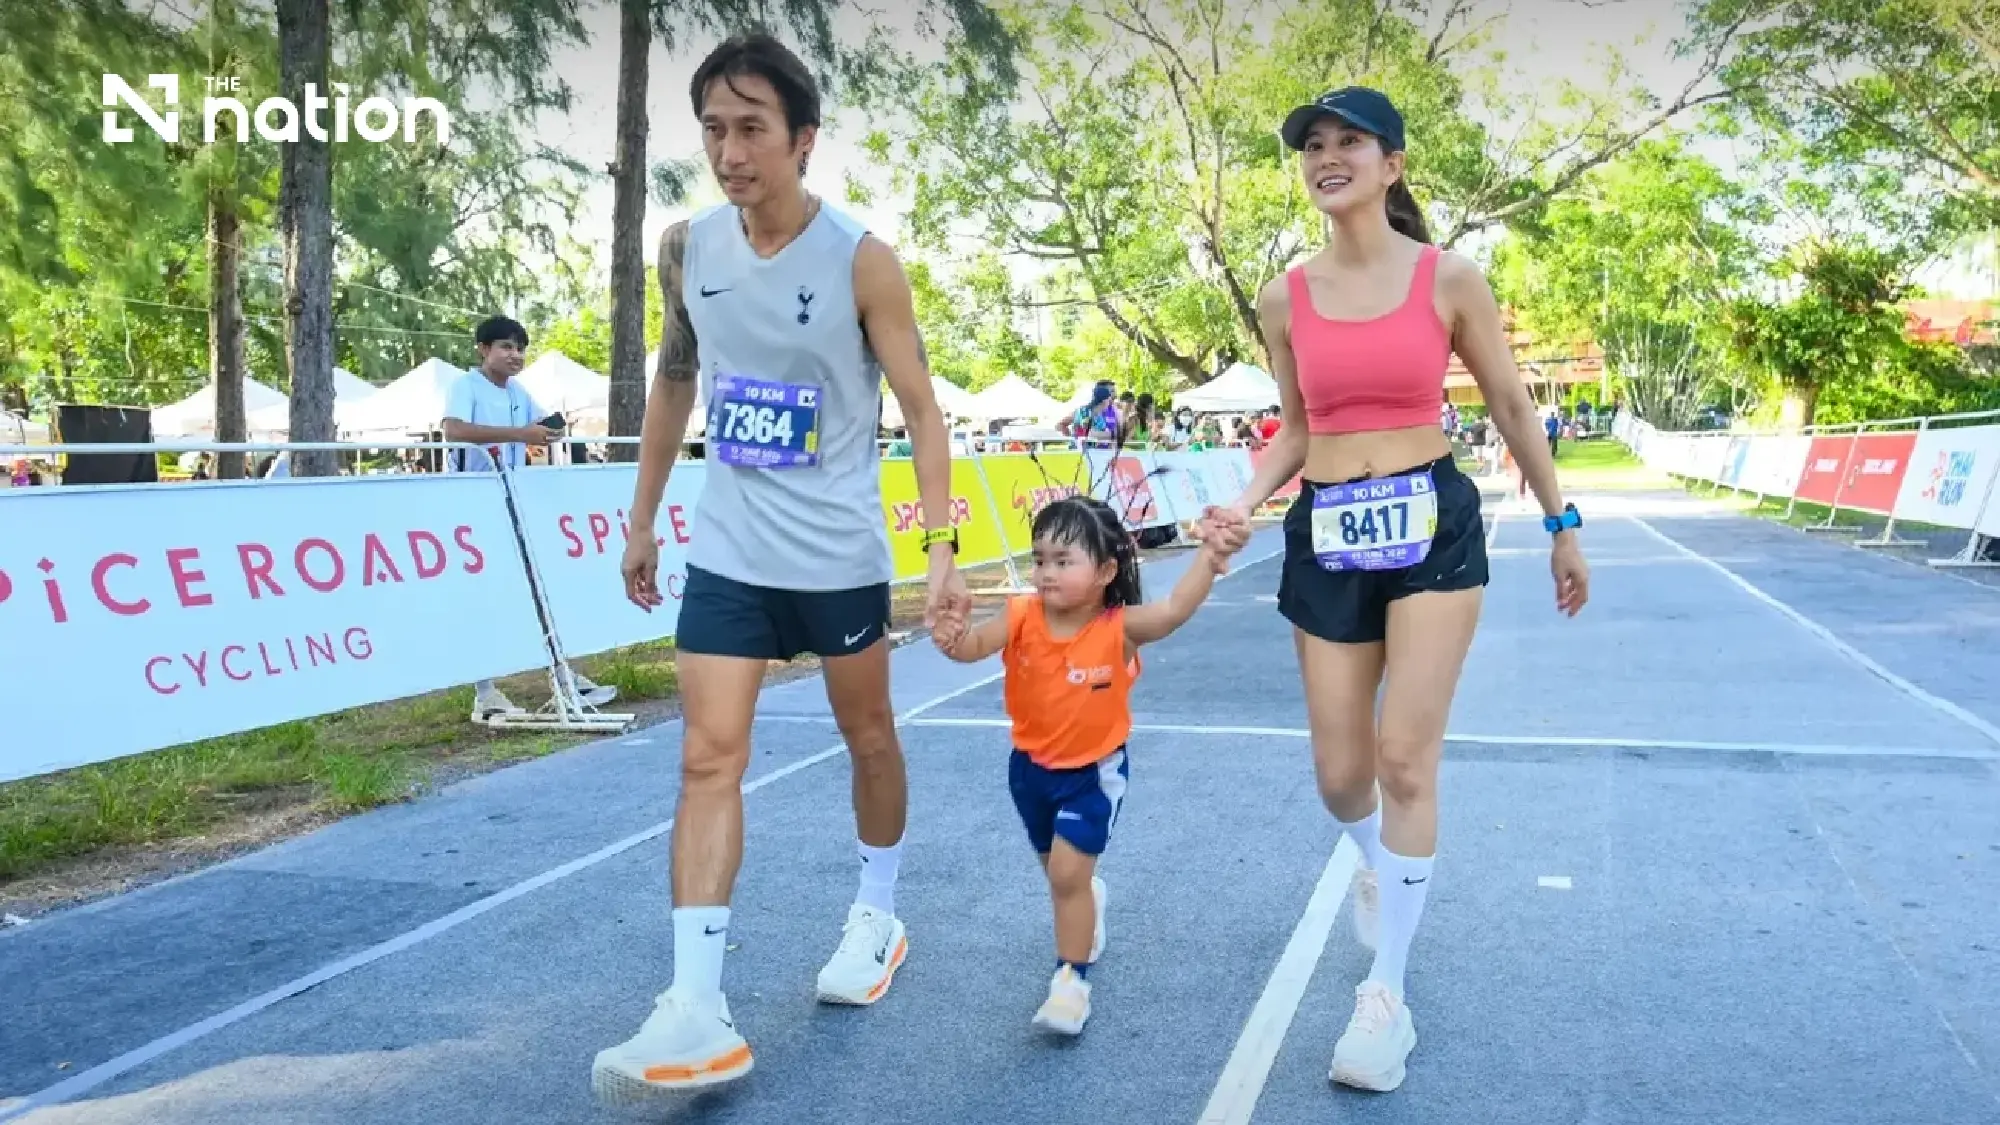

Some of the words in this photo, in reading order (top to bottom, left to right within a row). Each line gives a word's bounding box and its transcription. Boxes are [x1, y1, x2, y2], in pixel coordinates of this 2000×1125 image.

[745, 386, 759, 400] 10
[762, 388, 785, 402] KM
[723, 402, 794, 446] 7364
[1352, 488, 1368, 500] 10
[1370, 483, 1395, 497] KM
[1340, 502, 1408, 545] 8417
[237, 525, 485, 599] ROADS
[145, 627, 373, 694] CYCLING
